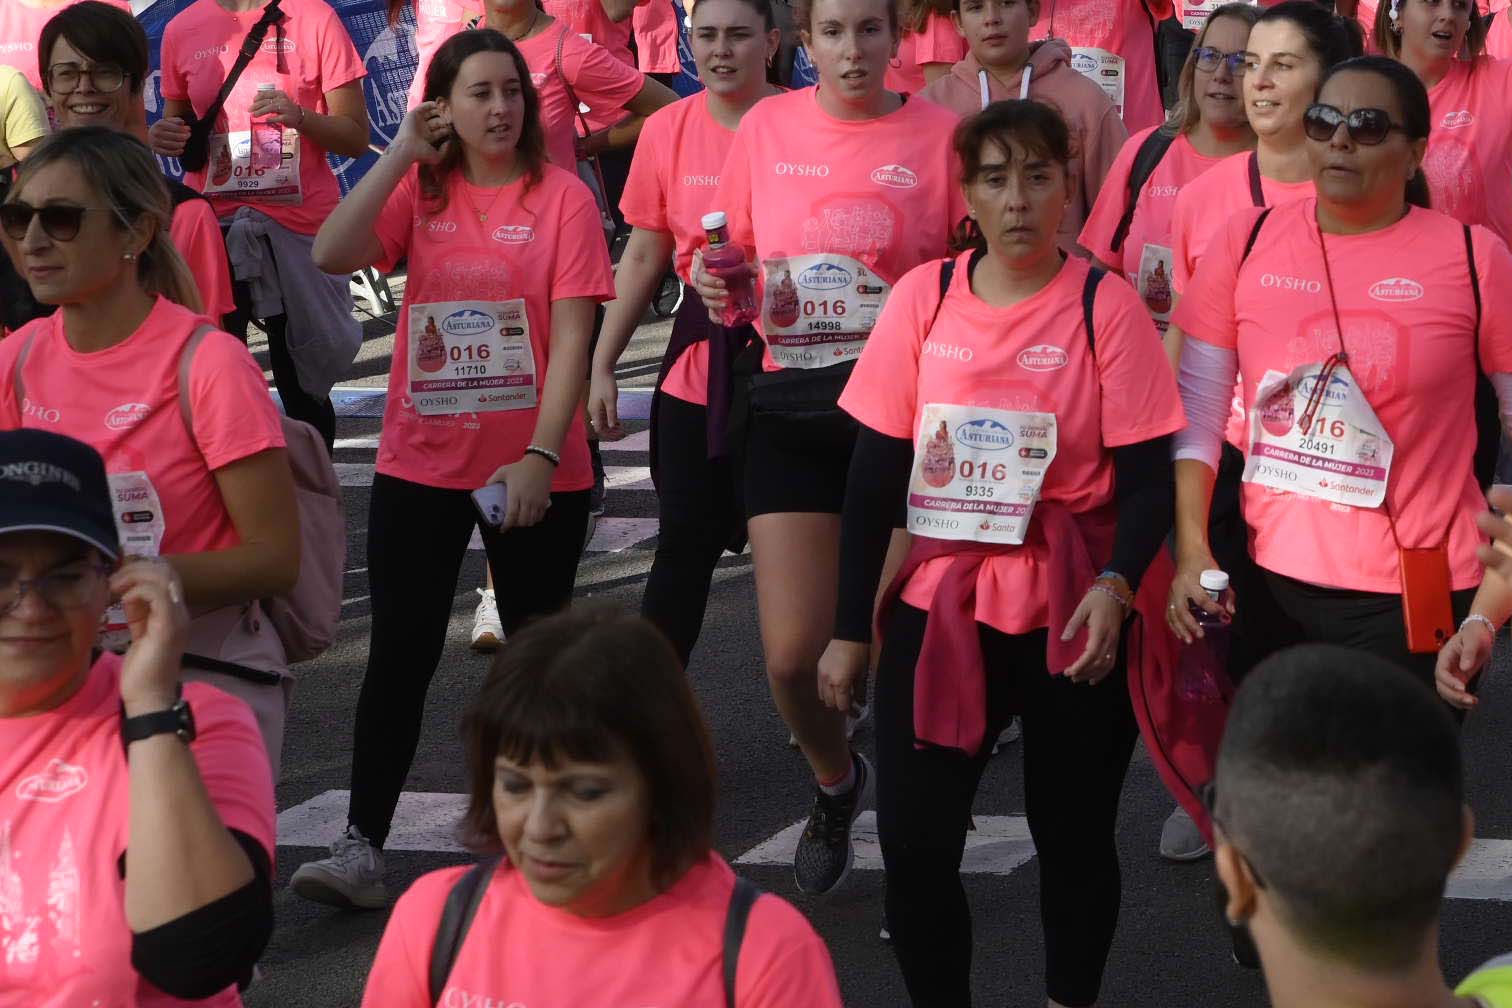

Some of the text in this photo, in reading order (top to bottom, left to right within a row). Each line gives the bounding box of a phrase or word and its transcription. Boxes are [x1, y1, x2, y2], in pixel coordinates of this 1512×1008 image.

[775, 161, 830, 177] OYSHO
[801, 274, 848, 284] ASTURIANA
[1259, 273, 1321, 293] OYSHO
[803, 300, 847, 315] 016
[446, 319, 491, 330] ASTURIANA
[807, 320, 841, 331] 14998
[449, 344, 491, 361] 016
[780, 351, 813, 361] OYSHO
[921, 342, 973, 363] OYSHO
[455, 365, 487, 375] 11710
[423, 381, 456, 389] CARRERA
[420, 393, 527, 407] OYSHO Santander
[959, 427, 1048, 446] ASTURIANA SUMA
[1299, 438, 1336, 454] 20491
[1263, 447, 1299, 462] CARRERA
[1300, 454, 1311, 463] DE
[1312, 457, 1323, 467] LA
[1324, 459, 1353, 473] MUJER
[959, 460, 1008, 482] 016
[1256, 464, 1375, 496] OYSHO Santander
[965, 484, 994, 498] 9335
[924, 499, 962, 510] CARRERA
[987, 503, 1014, 514] MUJER
[915, 515, 960, 529] OYSHO
